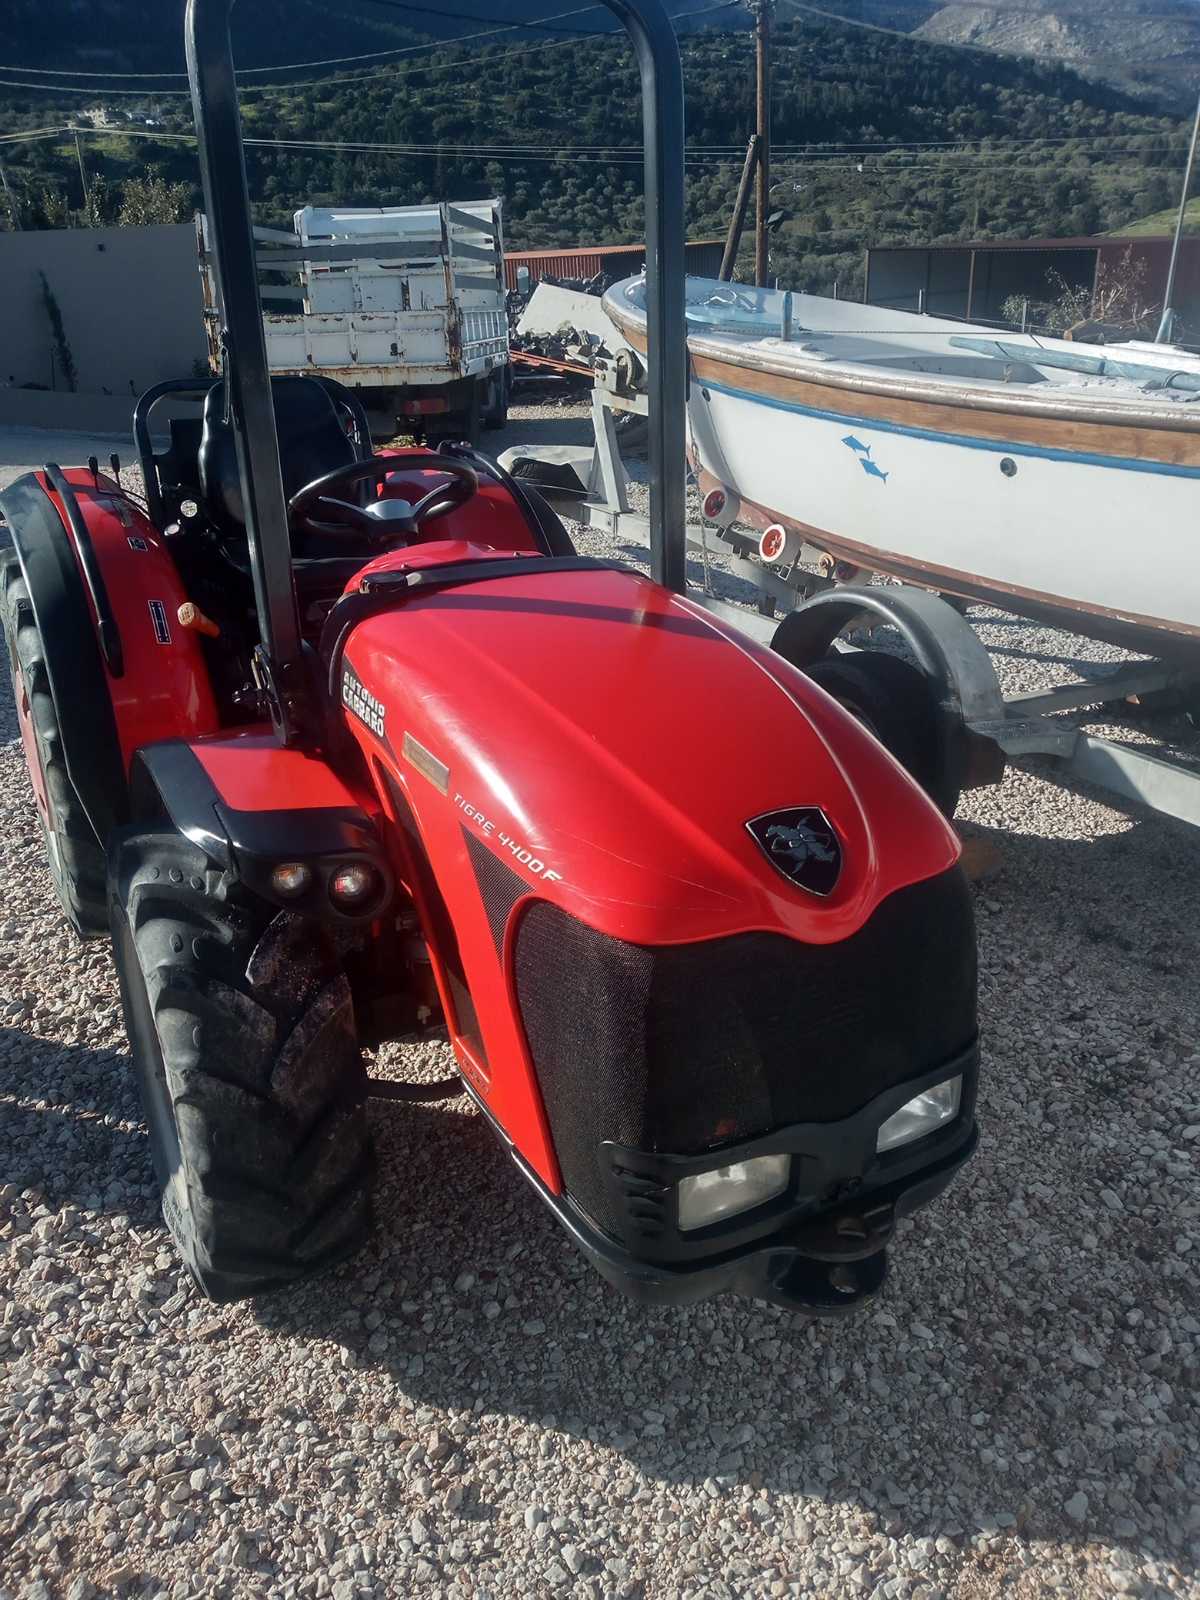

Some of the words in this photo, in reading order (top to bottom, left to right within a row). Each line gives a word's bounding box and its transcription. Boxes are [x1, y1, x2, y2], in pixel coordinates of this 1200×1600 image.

[342, 684, 384, 737] CARRARO
[343, 671, 385, 717] ANTONIO
[453, 792, 496, 833] TIGRE
